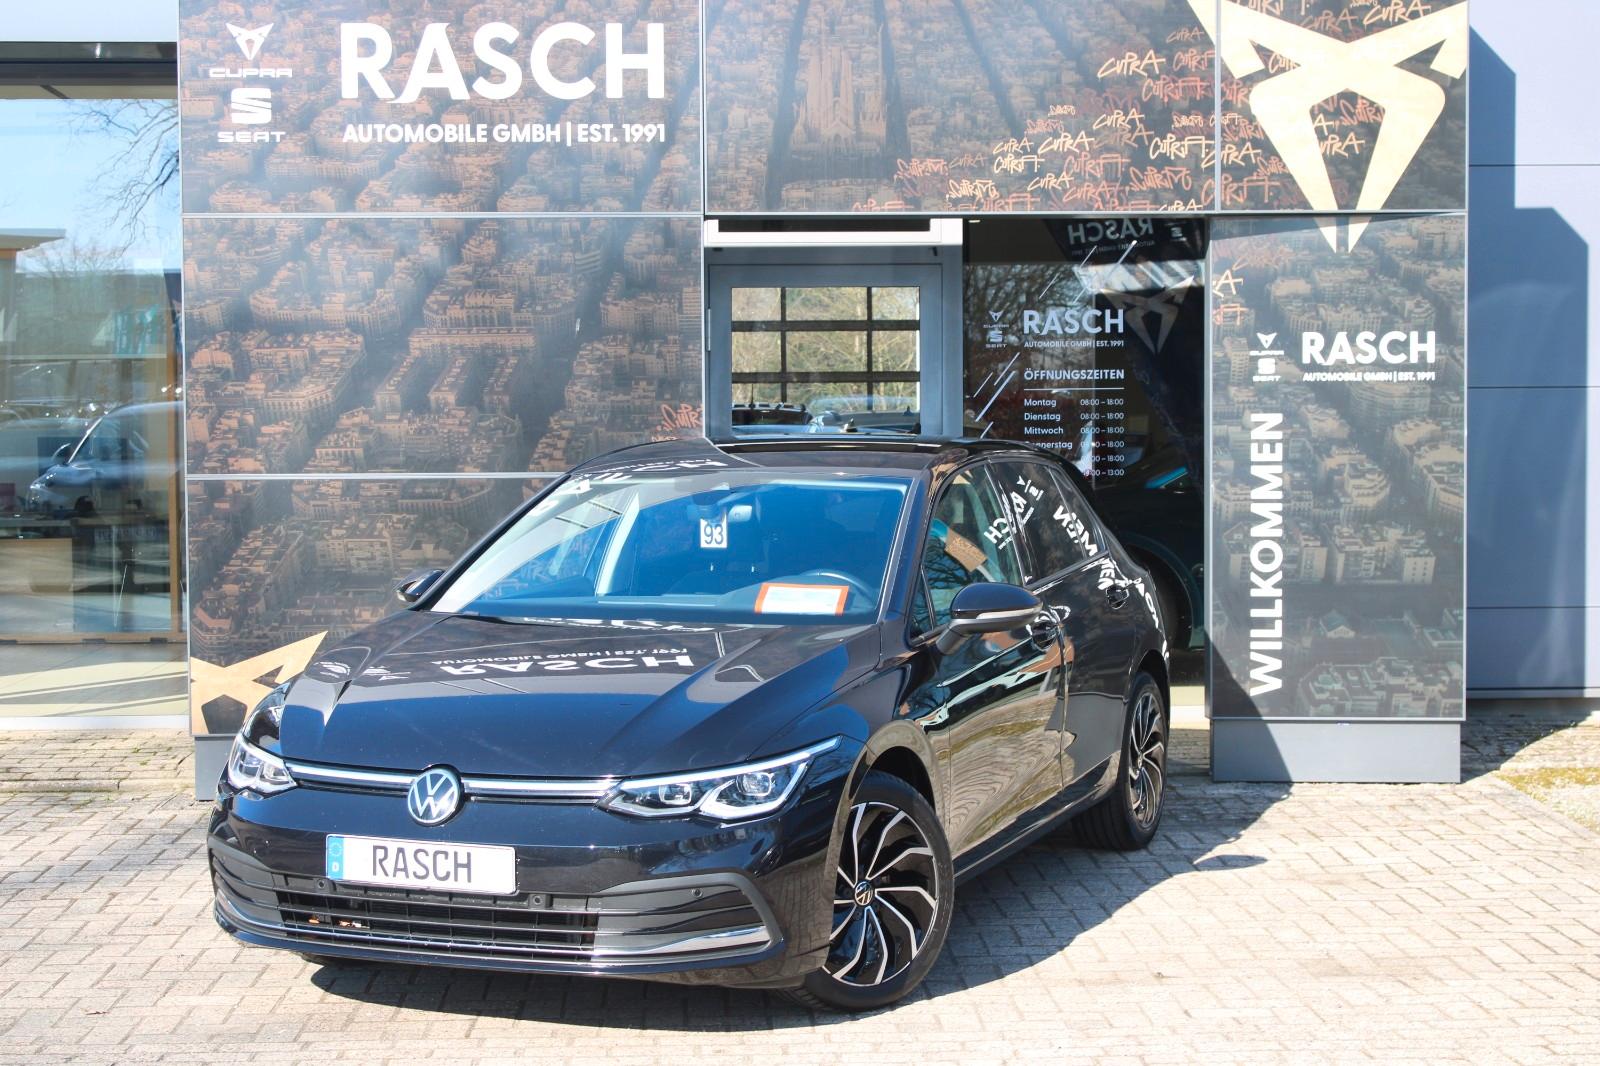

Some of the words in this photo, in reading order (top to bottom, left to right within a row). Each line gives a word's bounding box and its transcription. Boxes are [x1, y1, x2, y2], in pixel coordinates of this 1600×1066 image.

[340, 22, 665, 104] RASCH
[1096, 49, 1166, 79] CUPRA
[208, 67, 293, 78] CUPRA
[1093, 107, 1145, 129] CUPRA
[217, 131, 286, 143] SEAT
[343, 123, 487, 143] AUTOMOBILE
[493, 123, 560, 143] GMBH
[577, 123, 618, 143] EST.
[624, 123, 665, 143] 1991
[1038, 130, 1095, 153] CUPRA
[993, 137, 1034, 154] CUPRA
[1318, 131, 1366, 158] UPRA
[1027, 172, 1075, 191] CUPRA
[1023, 309, 1124, 335] RASCH
[1024, 340, 1070, 348] AUTOMOBILE
[1302, 330, 1436, 365] RASCH
[1024, 368, 1124, 380] ÖFFNUNGSZEITEN
[1303, 372, 1363, 382] AUTOMOBILE
[1364, 372, 1393, 382] GMBH
[1398, 372, 1416, 382] EST.
[1418, 372, 1436, 382] 1991
[1024, 399, 1057, 407] Montag
[1107, 398, 1124, 406] 18:00
[1024, 412, 1061, 421] Dienstag
[1107, 412, 1124, 420] 18:00
[1024, 427, 1064, 435] Mittwoch
[1107, 426, 1124, 434] 18:00
[1107, 440, 1124, 448] 18:00
[1107, 454, 1124, 462] 18:00
[1107, 468, 1124, 476] 13:00
[703, 523, 725, 545] 93
[1250, 412, 1284, 697] WILLKOMMEN
[372, 845, 472, 883] RASCH
